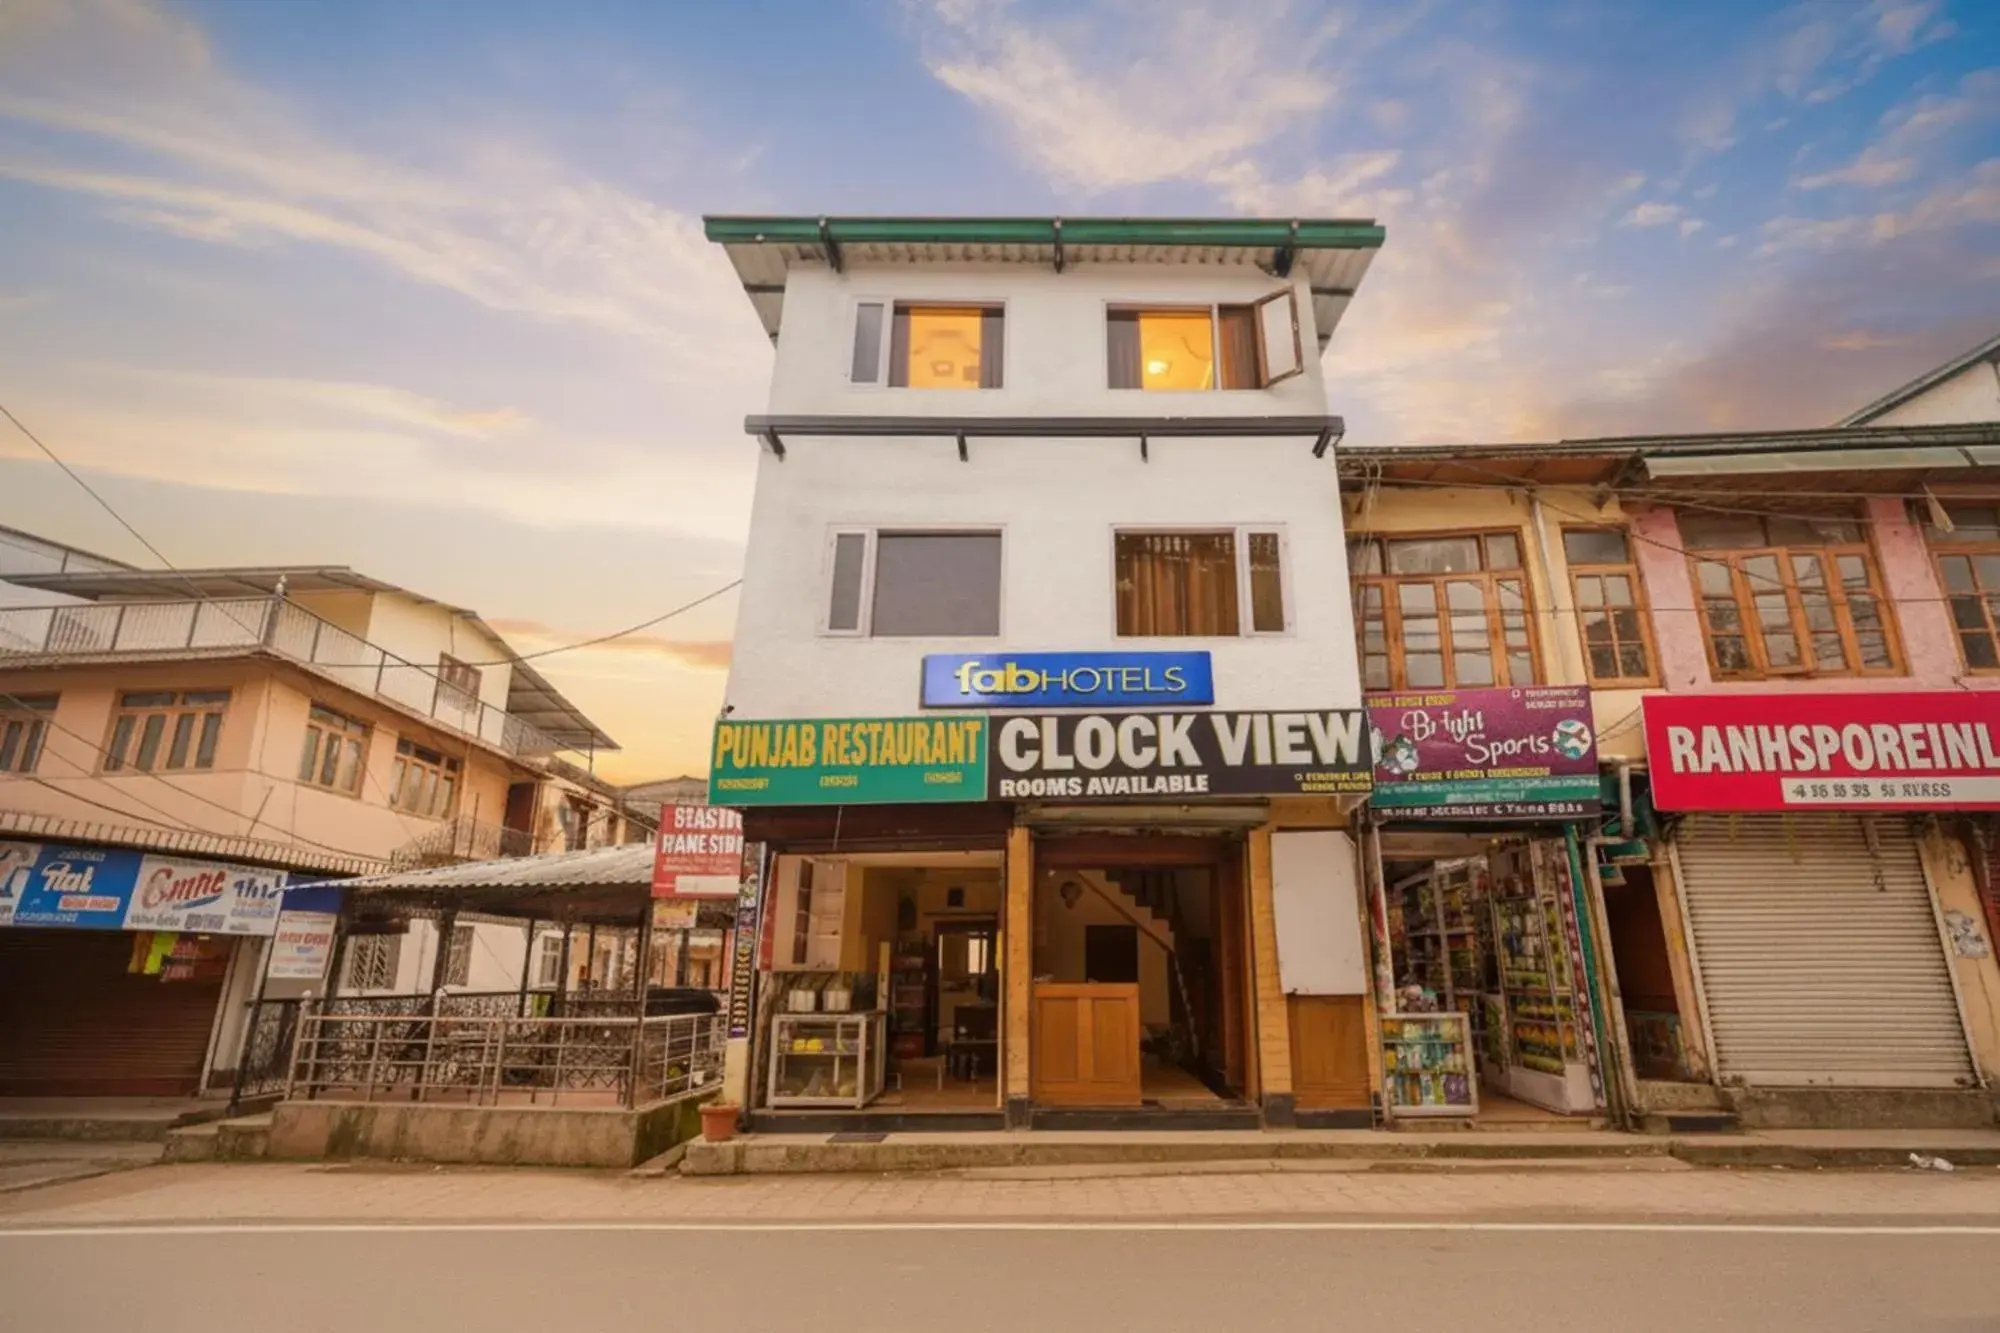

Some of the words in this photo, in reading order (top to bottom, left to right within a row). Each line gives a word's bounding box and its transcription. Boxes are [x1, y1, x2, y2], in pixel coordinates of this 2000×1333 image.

[954, 661, 1187, 694] fabHOTELS
[715, 724, 817, 769] PUNJAB
[821, 721, 982, 767] RESTAURANT
[999, 715, 1203, 772] CLOCK
[1210, 712, 1362, 766] VIEW
[1465, 734, 1550, 766] Sports
[1000, 778, 1082, 797] ROOMS
[1086, 774, 1209, 796] AVAILABLE
